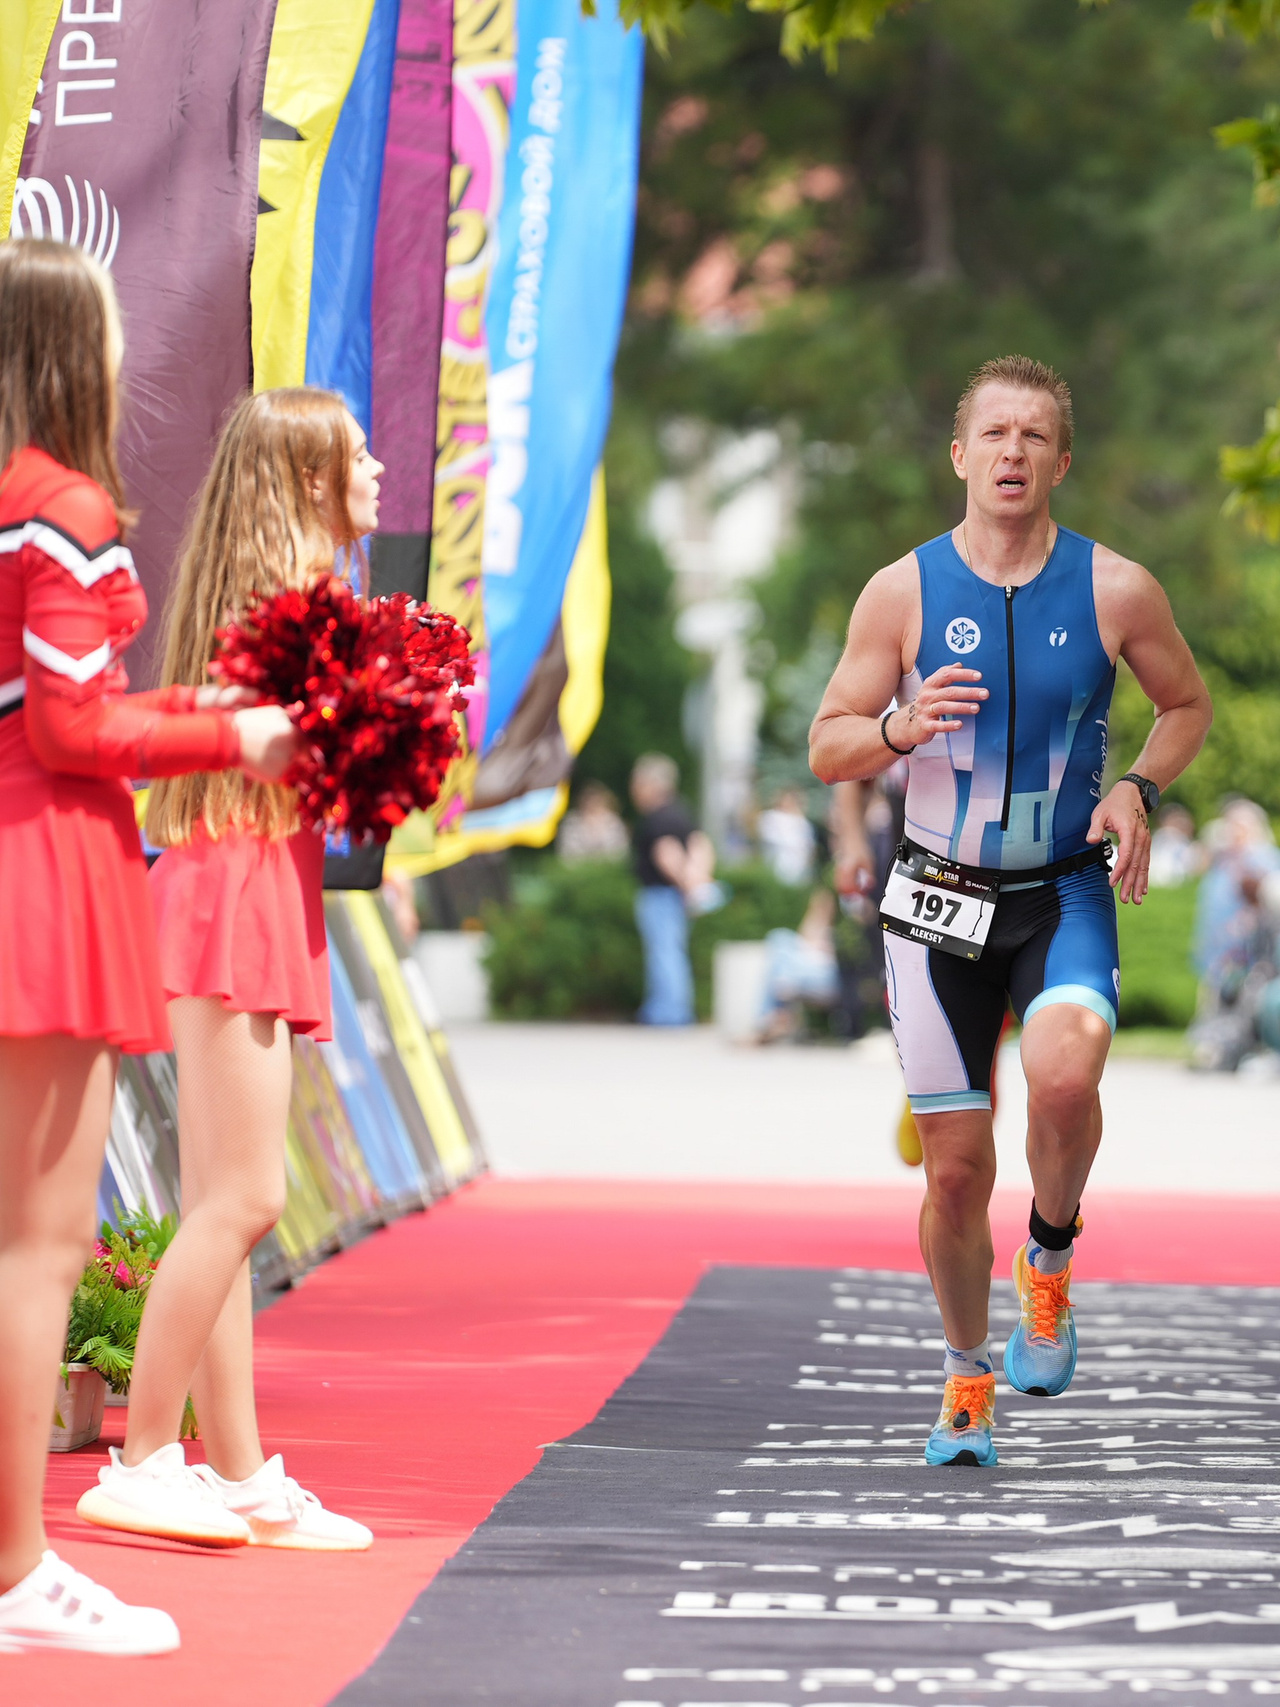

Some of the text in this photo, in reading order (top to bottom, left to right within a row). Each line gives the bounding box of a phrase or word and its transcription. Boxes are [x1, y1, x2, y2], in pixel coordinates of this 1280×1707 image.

[527, 36, 569, 133] ДОМ
[924, 864, 939, 876] IRON
[943, 871, 960, 882] STAR
[911, 890, 963, 928] 197
[909, 927, 944, 944] ALEKSEY
[714, 1511, 1047, 1527] IRON
[672, 1591, 1052, 1616] IRON
